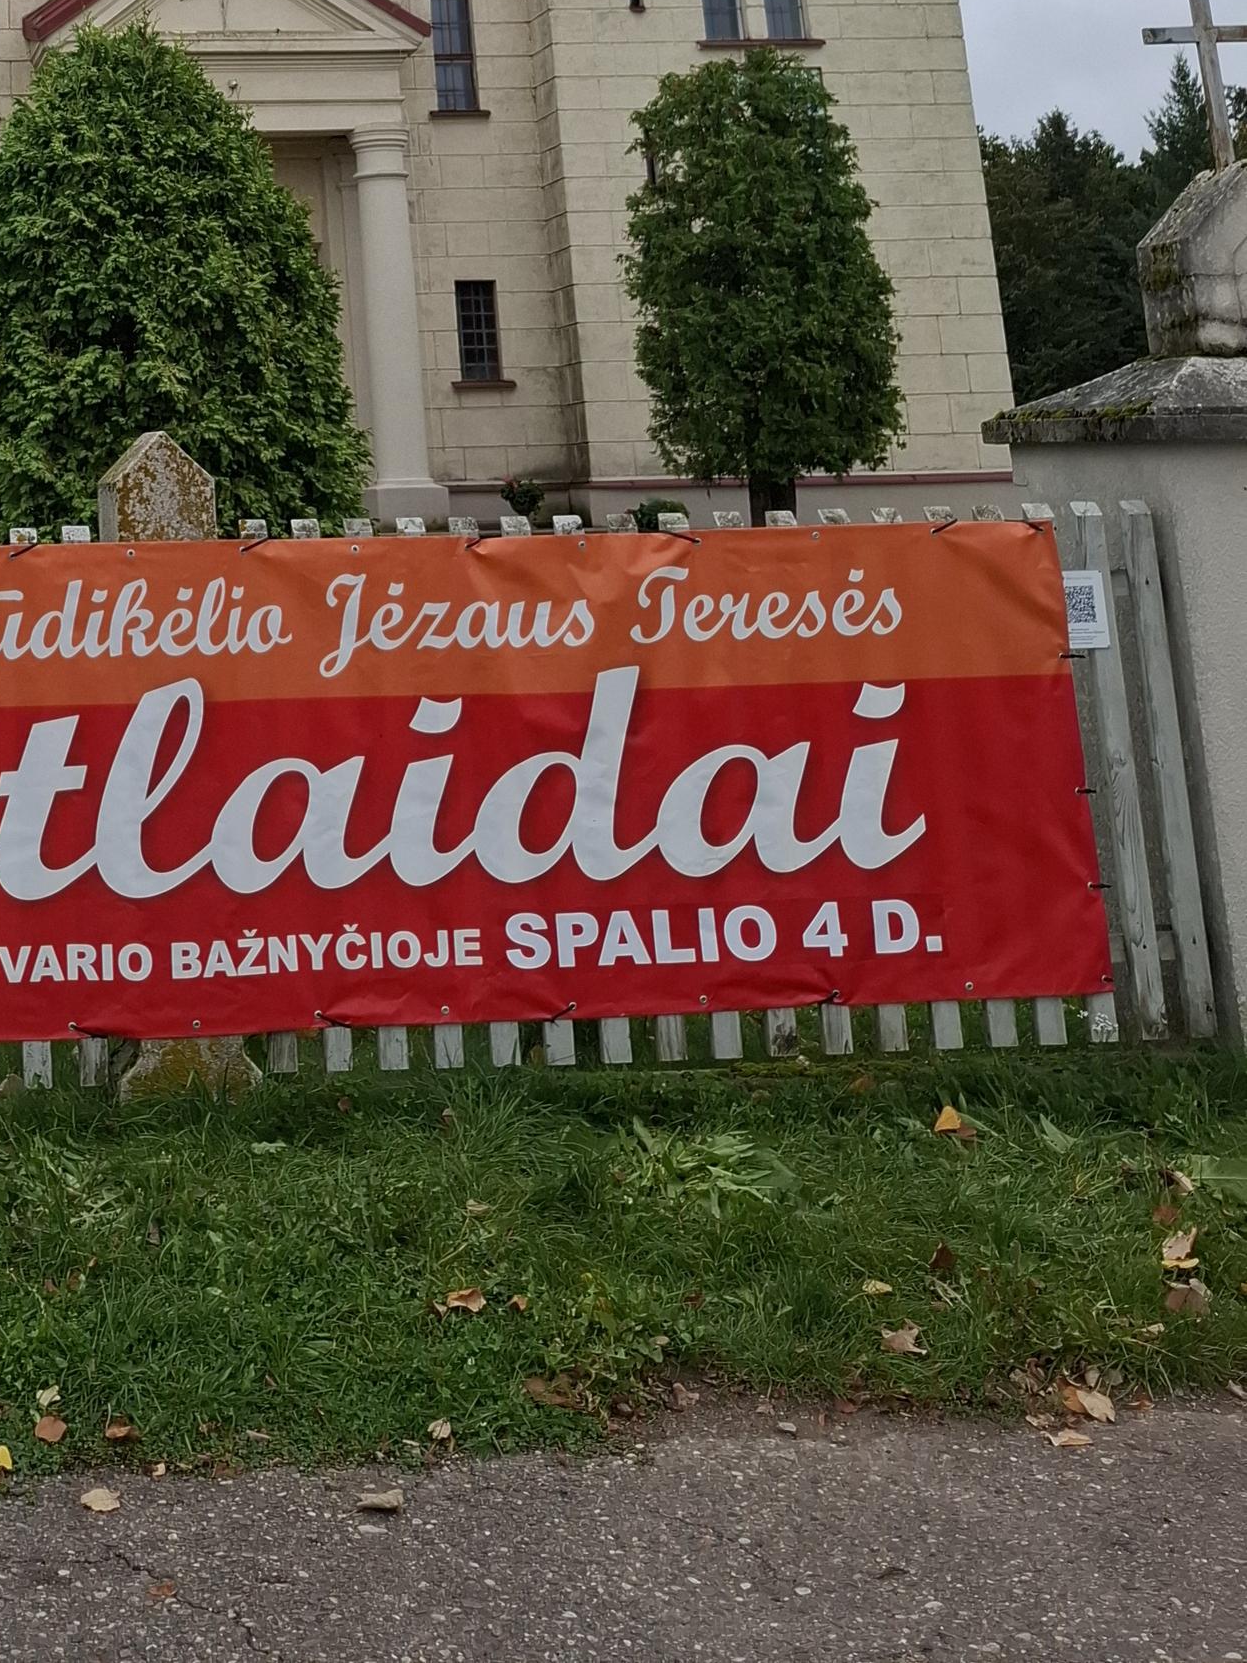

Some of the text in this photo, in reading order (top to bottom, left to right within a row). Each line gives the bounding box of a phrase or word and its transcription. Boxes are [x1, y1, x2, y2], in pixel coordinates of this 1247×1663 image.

[319, 573, 595, 678] Jėzaus
[629, 566, 903, 644] Teresės
[171, 924, 483, 980] BAŽNYČIOJE
[505, 904, 777, 969] SPALIO
[802, 901, 848, 957] 4
[871, 899, 943, 954] D.
